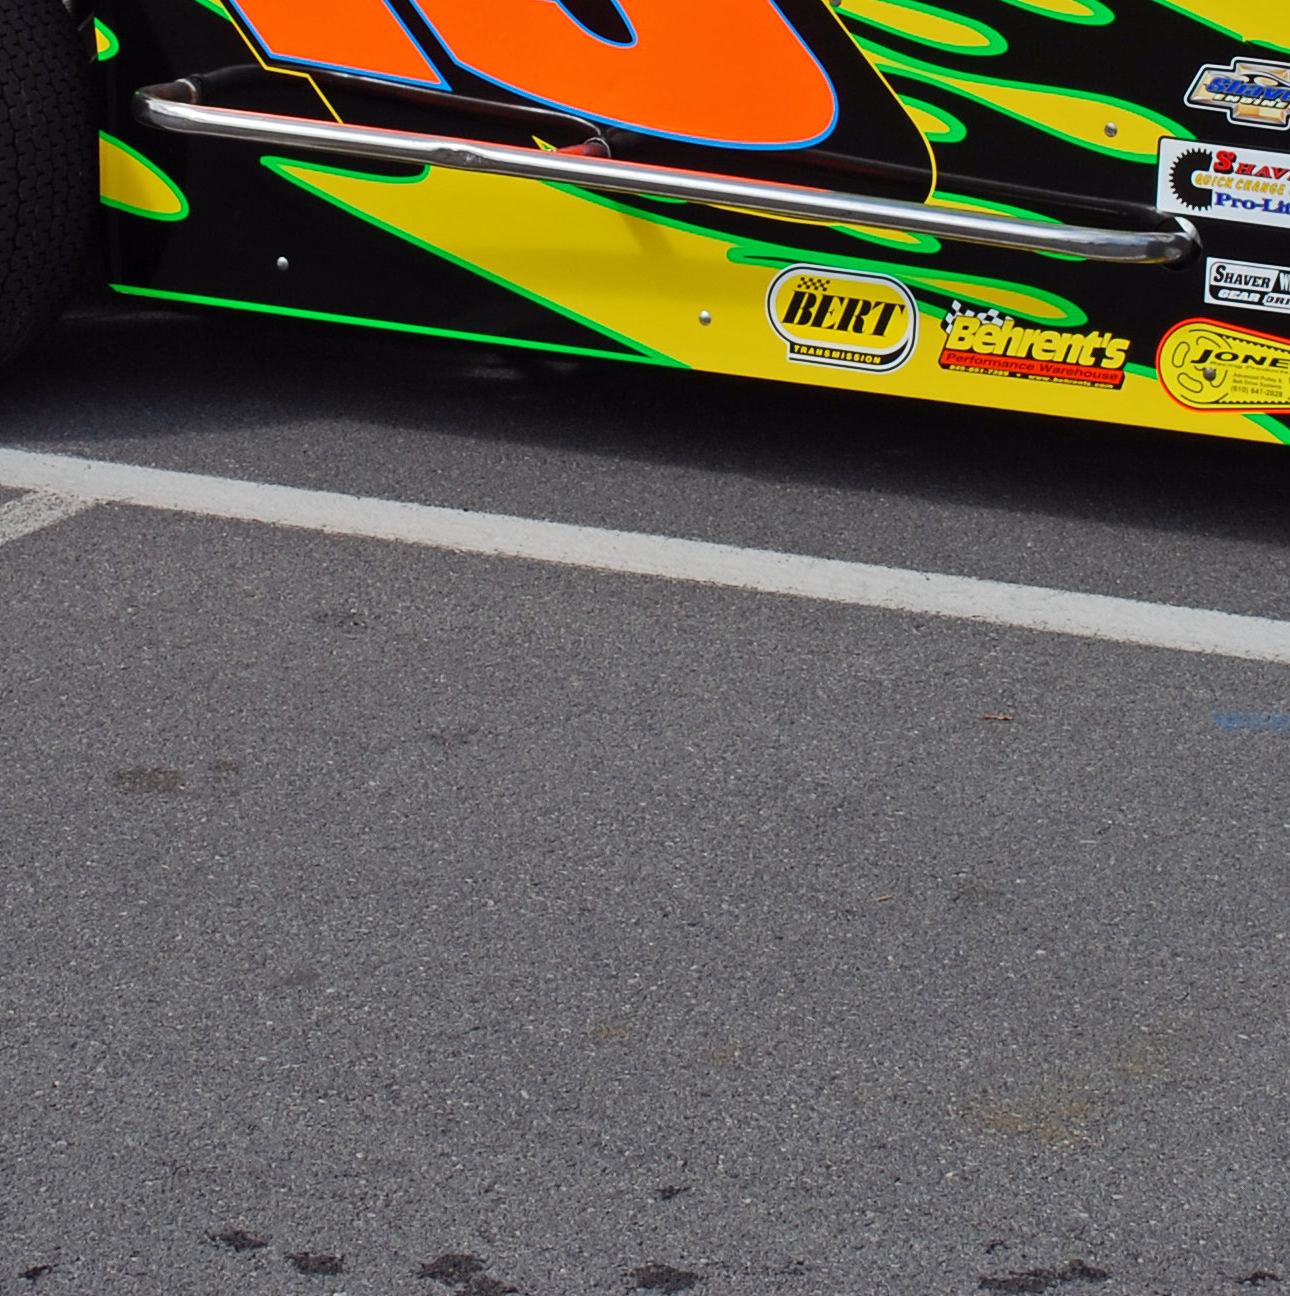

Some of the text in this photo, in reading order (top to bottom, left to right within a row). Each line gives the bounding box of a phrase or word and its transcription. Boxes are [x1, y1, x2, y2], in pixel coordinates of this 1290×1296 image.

[1194, 173, 1233, 189] QUICK
[1235, 178, 1286, 196] CHANGE
[1218, 289, 1261, 303] GEAR
[781, 289, 907, 338] BERT
[793, 344, 882, 364] TRANSMISSION
[945, 315, 1131, 369] Behrent's
[946, 352, 1036, 371] Performance
[1039, 363, 1118, 381] Warehouse
